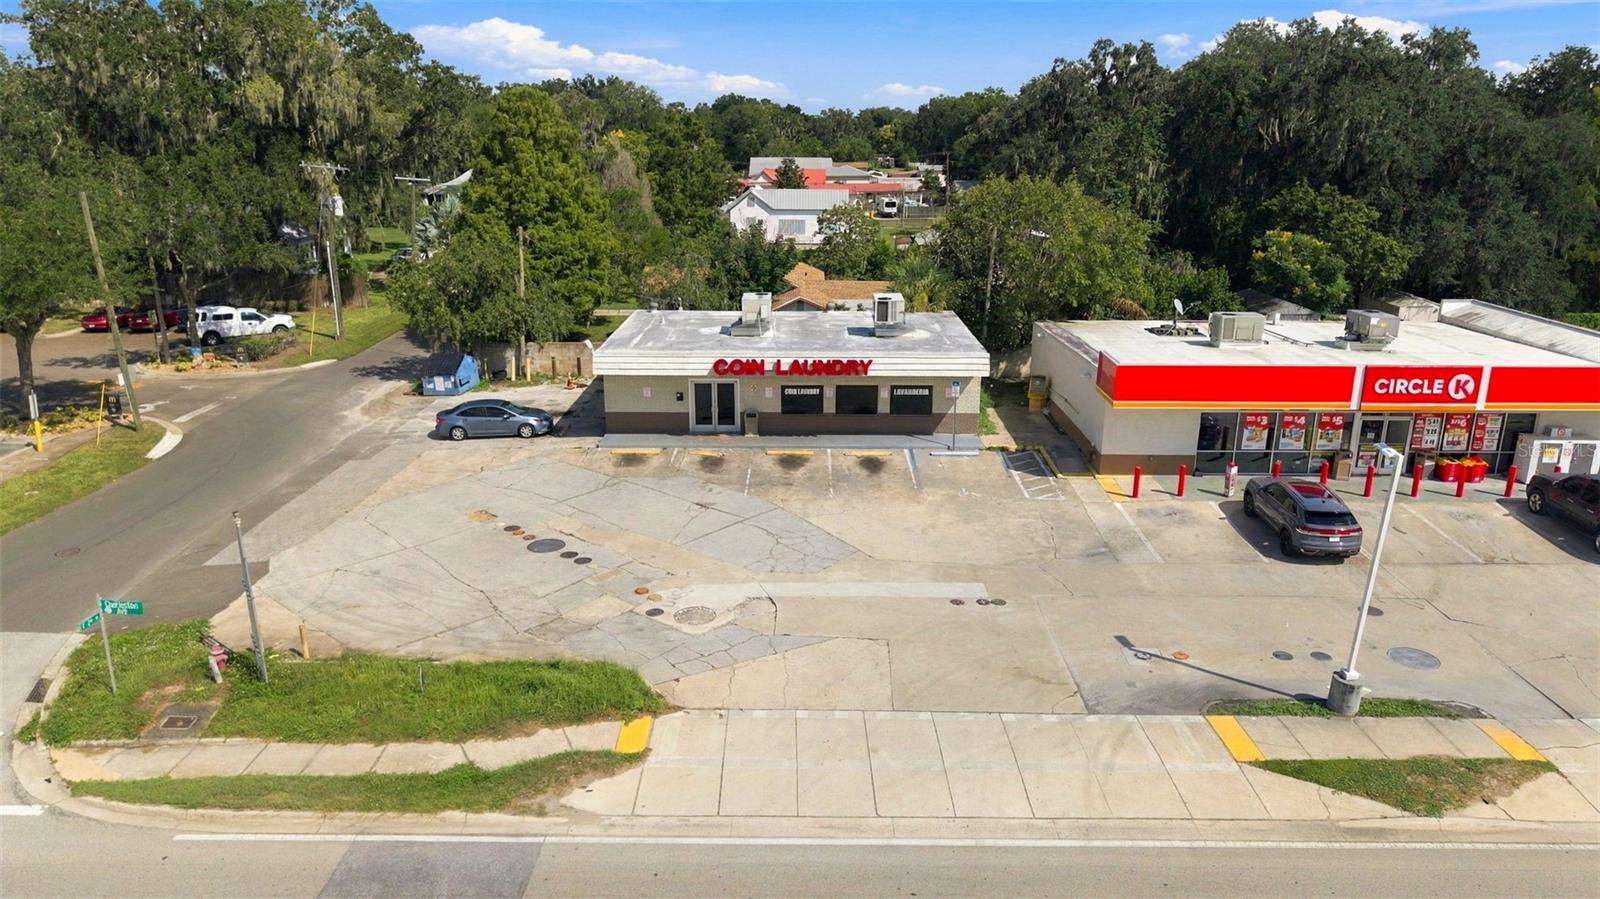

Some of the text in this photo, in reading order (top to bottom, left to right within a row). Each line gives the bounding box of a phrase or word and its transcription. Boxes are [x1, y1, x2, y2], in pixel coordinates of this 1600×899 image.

[713, 359, 873, 376] COIN LAUNDRY
[893, 388, 929, 396] LAVANDERIA
[1374, 377, 1473, 399] CIRCLE K
